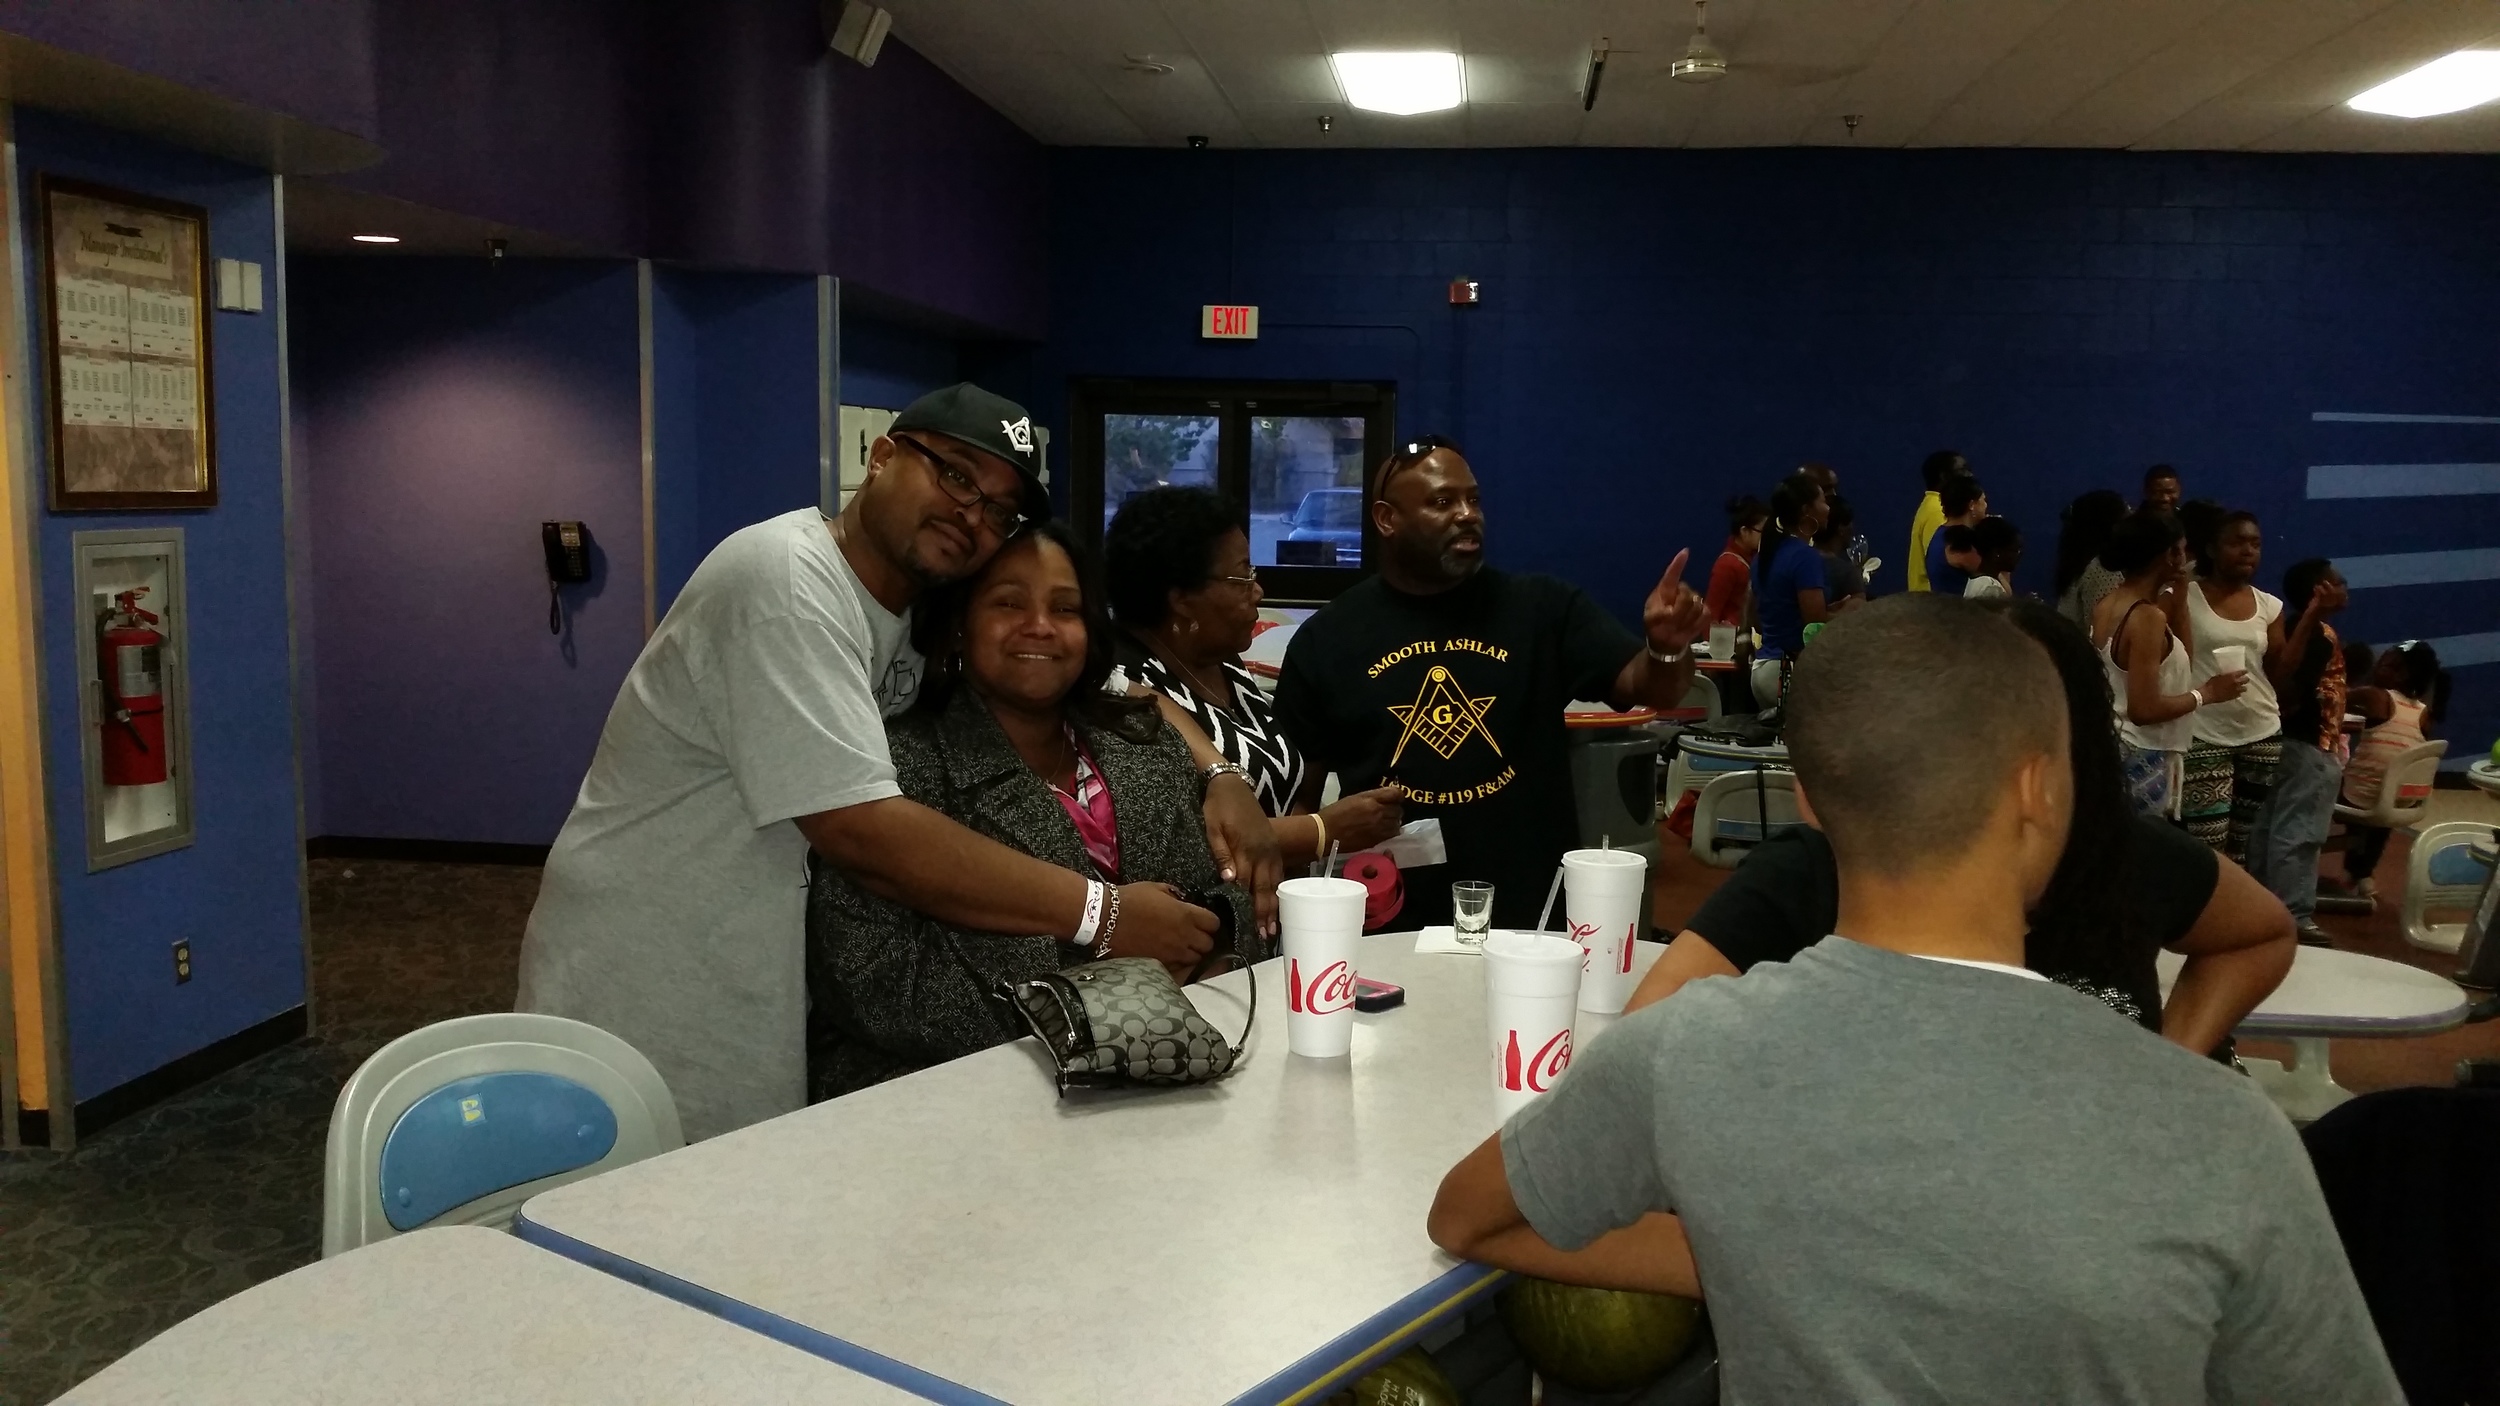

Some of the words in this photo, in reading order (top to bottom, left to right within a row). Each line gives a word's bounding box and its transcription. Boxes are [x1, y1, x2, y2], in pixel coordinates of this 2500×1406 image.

[1213, 307, 1249, 335] EXIT
[1367, 641, 1437, 679] SMOOTH
[1443, 638, 1509, 663] ASHLAR
[1432, 704, 1453, 725] G
[1437, 789, 1473, 805] #119
[1475, 765, 1516, 799] F&AM
